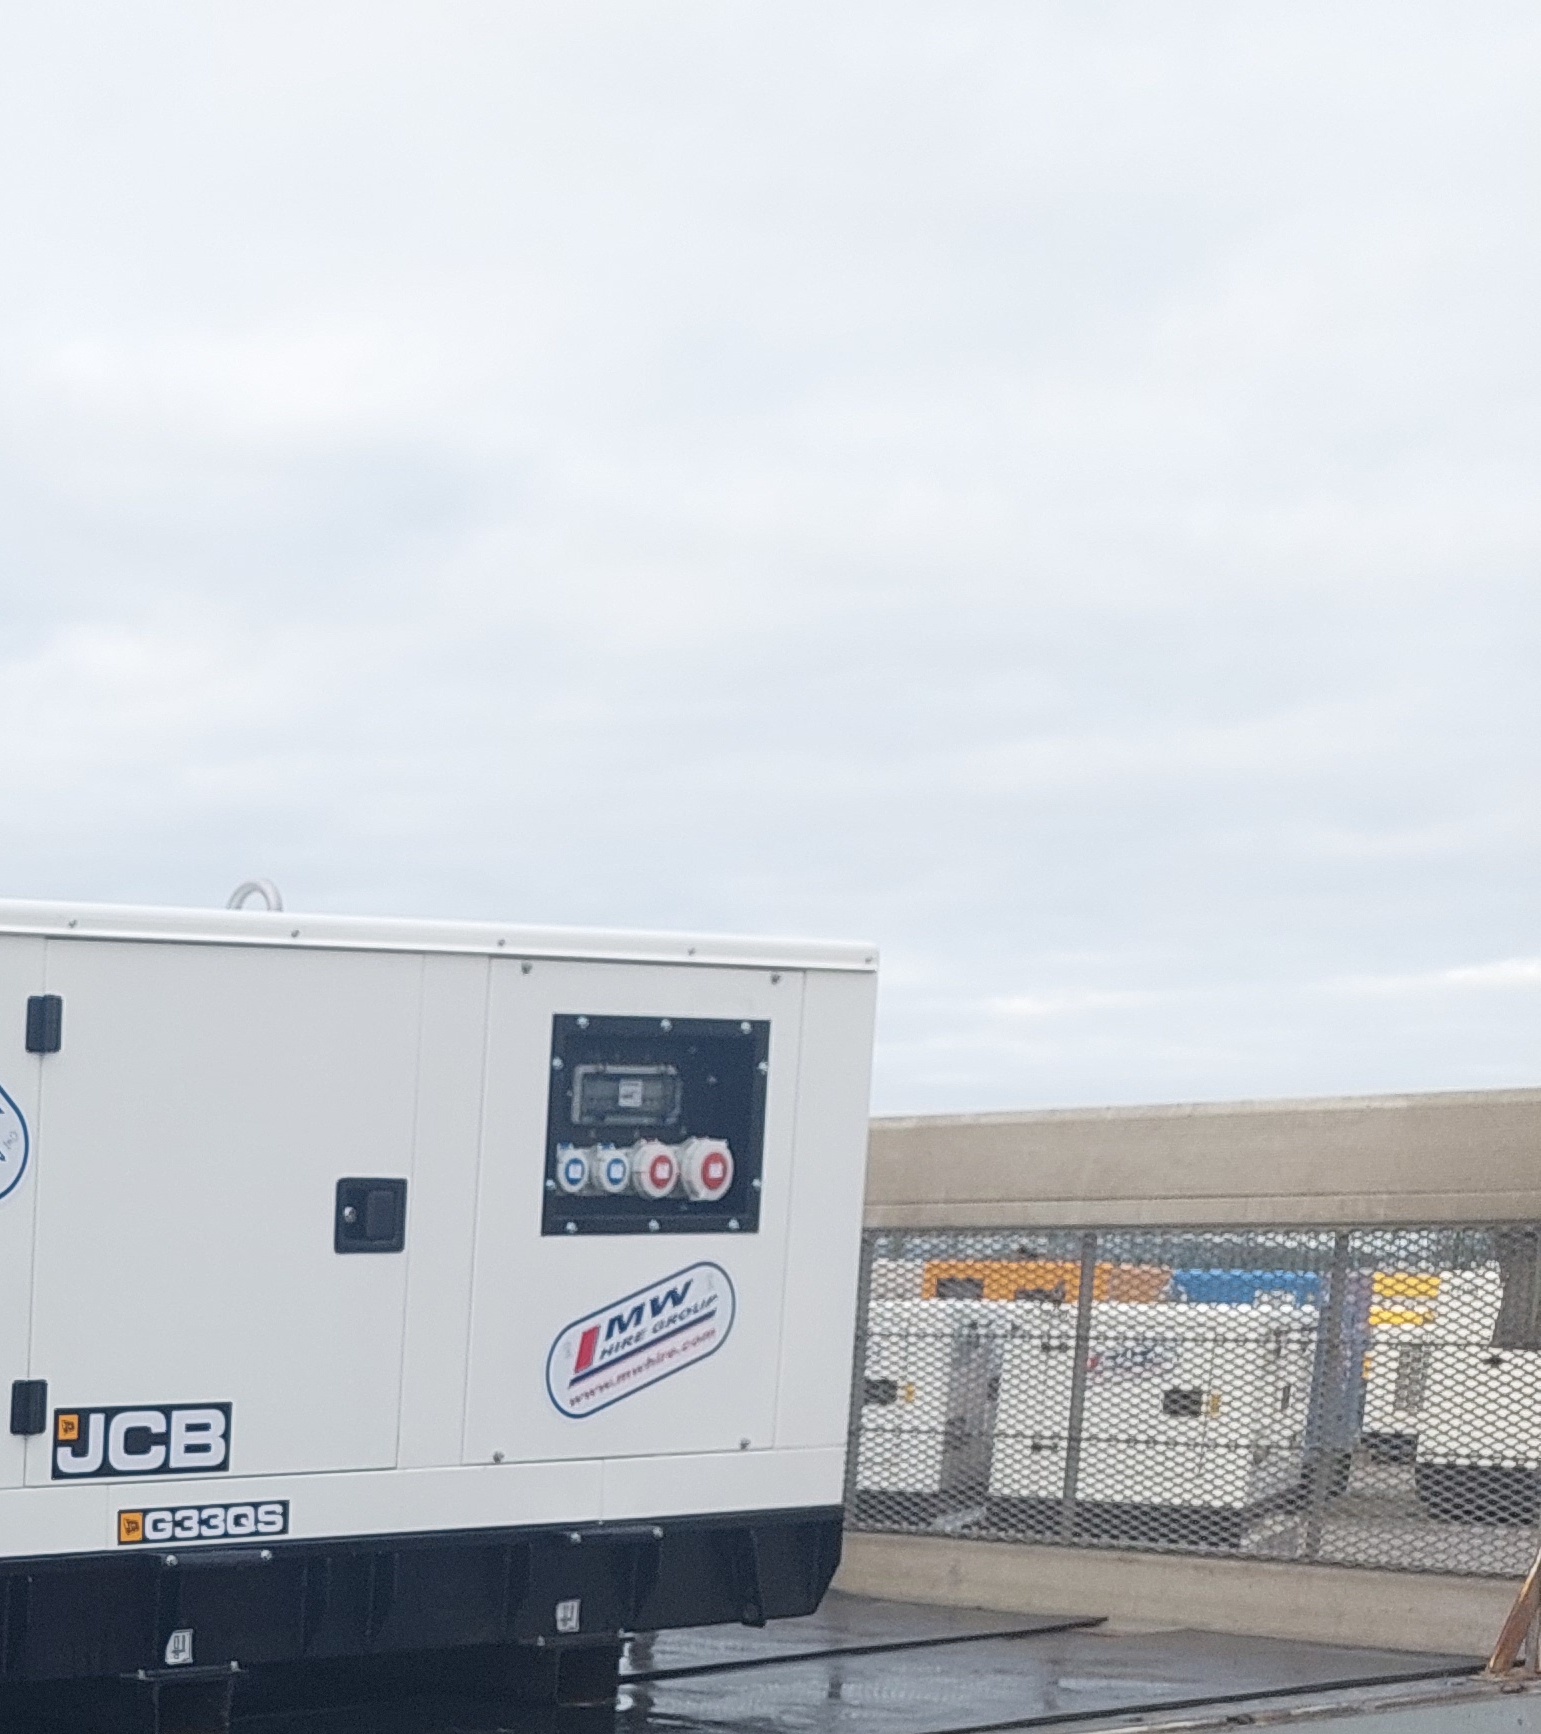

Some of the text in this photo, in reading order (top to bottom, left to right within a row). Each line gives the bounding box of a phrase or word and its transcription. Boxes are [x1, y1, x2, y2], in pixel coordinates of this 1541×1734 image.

[604, 1277, 694, 1341] MW
[56, 1408, 226, 1474] JCB
[143, 1503, 284, 1541] G33QS
